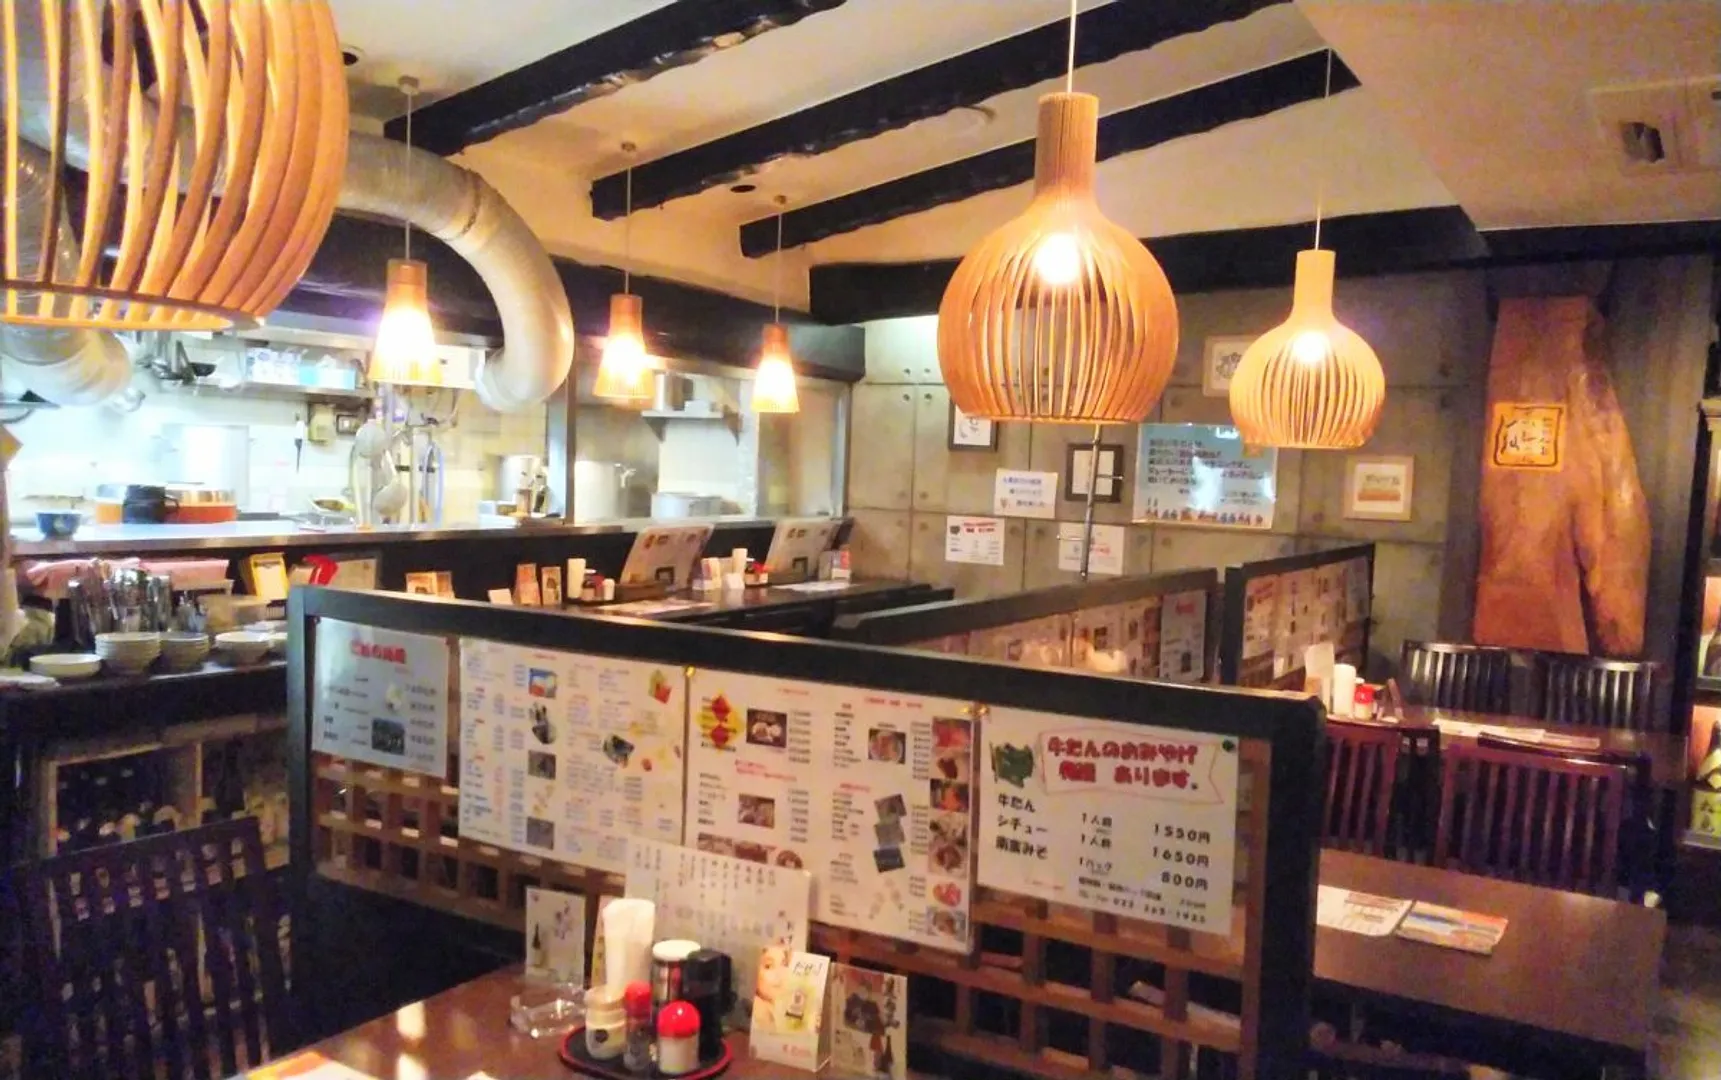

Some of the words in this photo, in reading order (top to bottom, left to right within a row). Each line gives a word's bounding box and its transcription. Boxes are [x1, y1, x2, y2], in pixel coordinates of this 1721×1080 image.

[998, 793, 1036, 813] 牛たん
[1154, 823, 1210, 844] 1550円
[998, 815, 1048, 835] シチュー
[1152, 846, 1209, 868] 1650円
